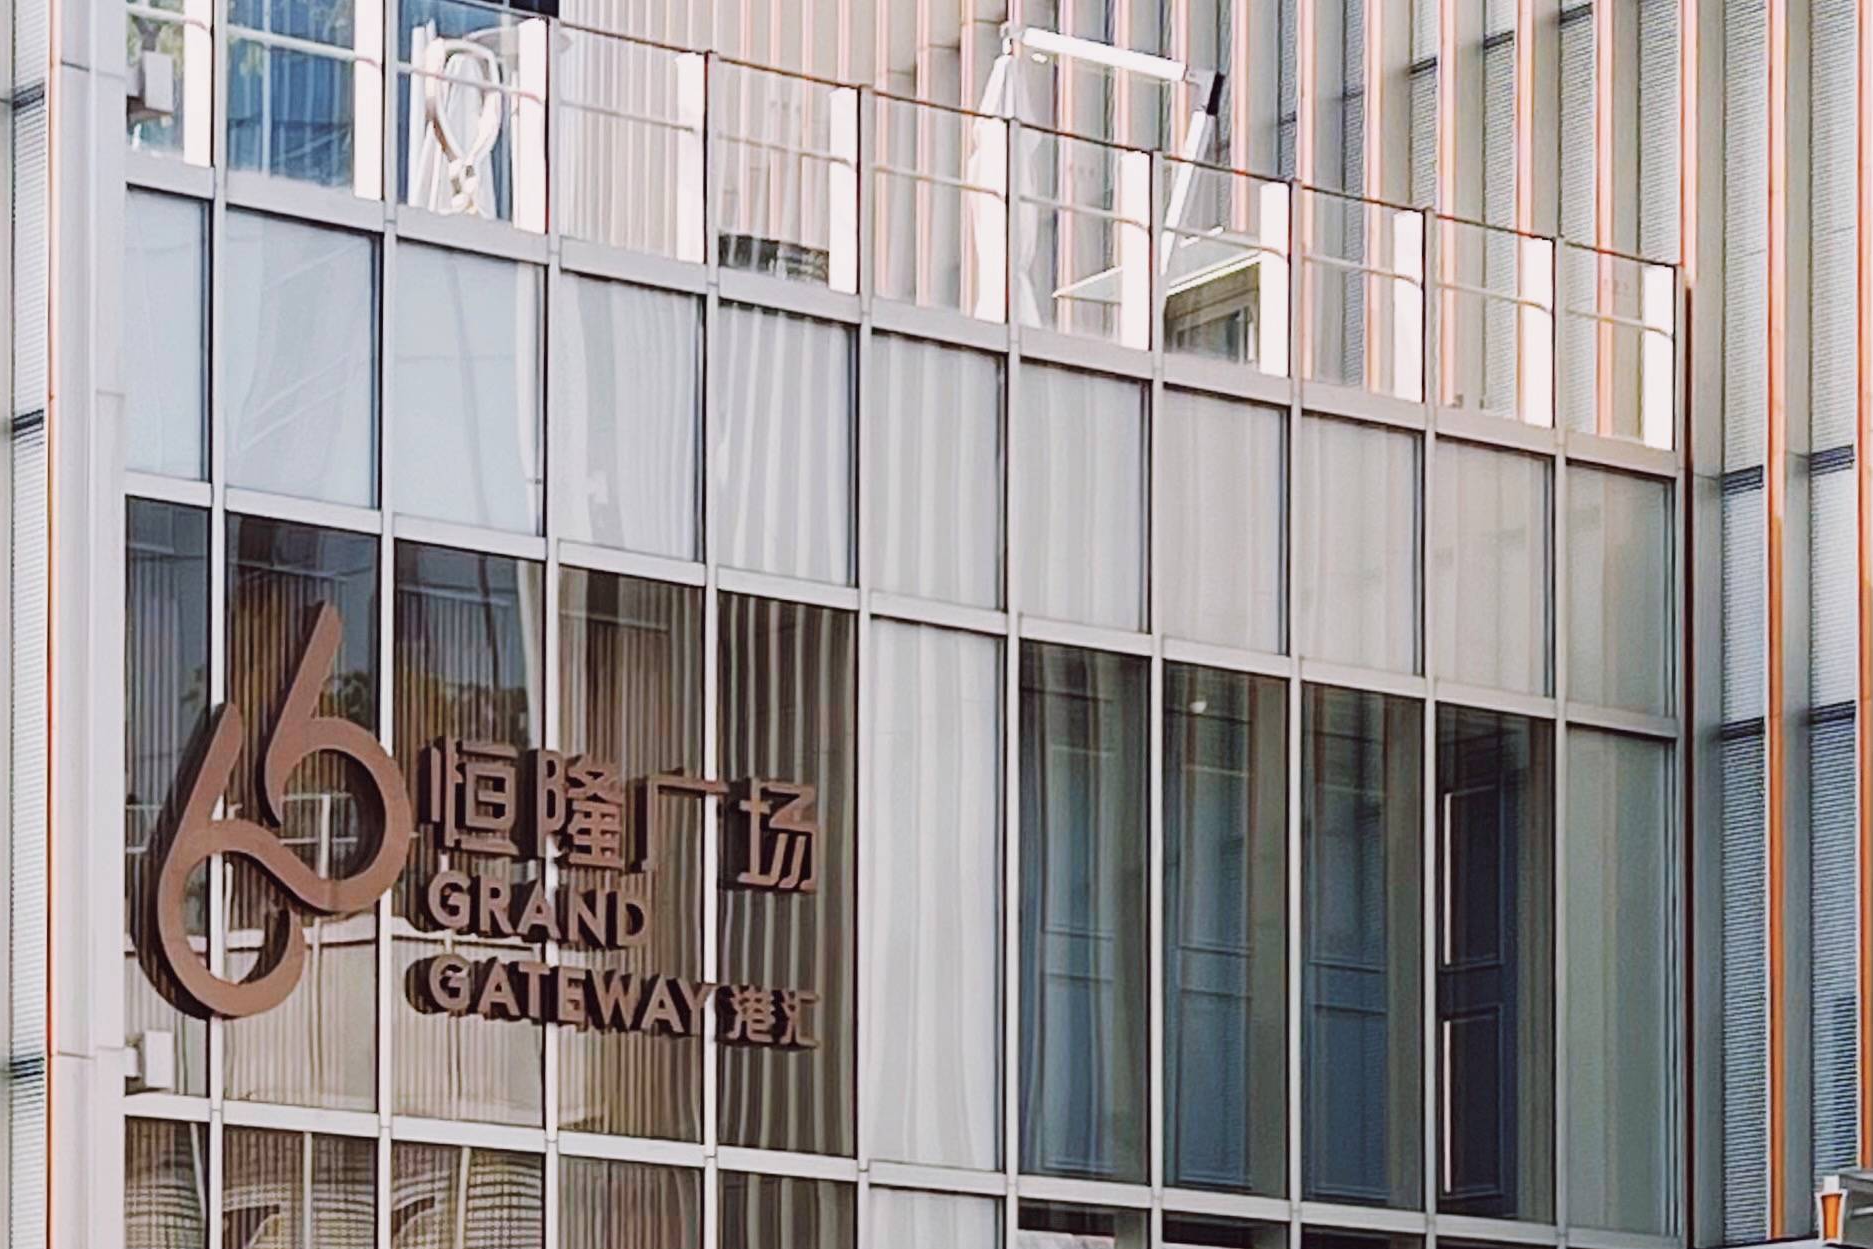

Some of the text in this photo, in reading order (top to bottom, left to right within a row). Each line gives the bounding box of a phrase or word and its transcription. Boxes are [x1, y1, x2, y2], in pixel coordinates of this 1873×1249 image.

[430, 737, 818, 890] 恒隆广场
[428, 869, 653, 948] GRAND
[429, 953, 821, 1047] GATEWAY 港汇
